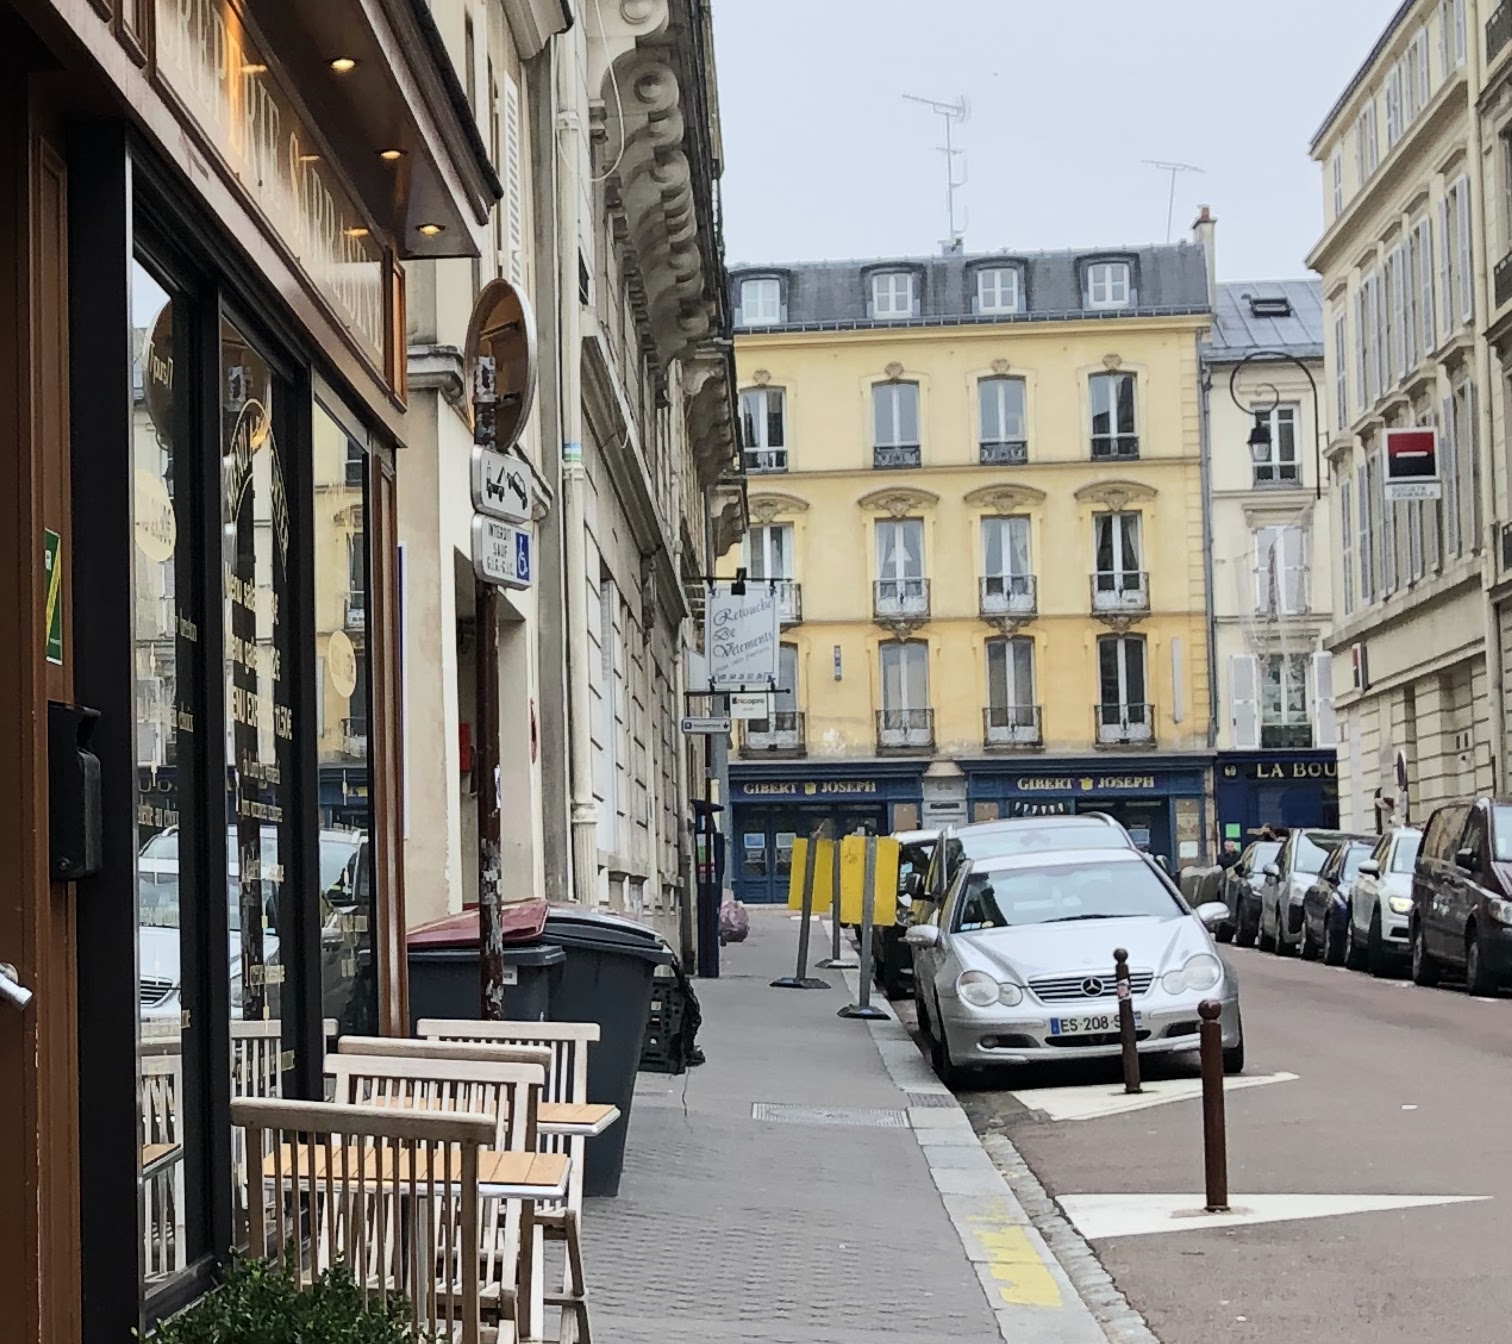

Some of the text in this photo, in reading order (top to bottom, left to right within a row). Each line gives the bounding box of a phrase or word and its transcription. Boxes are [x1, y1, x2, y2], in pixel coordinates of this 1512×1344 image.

[1256, 762, 1285, 779] LA
[743, 781, 877, 795] GIBERT JOSEPH
[1016, 776, 1155, 791] GIBERT JOSEPH
